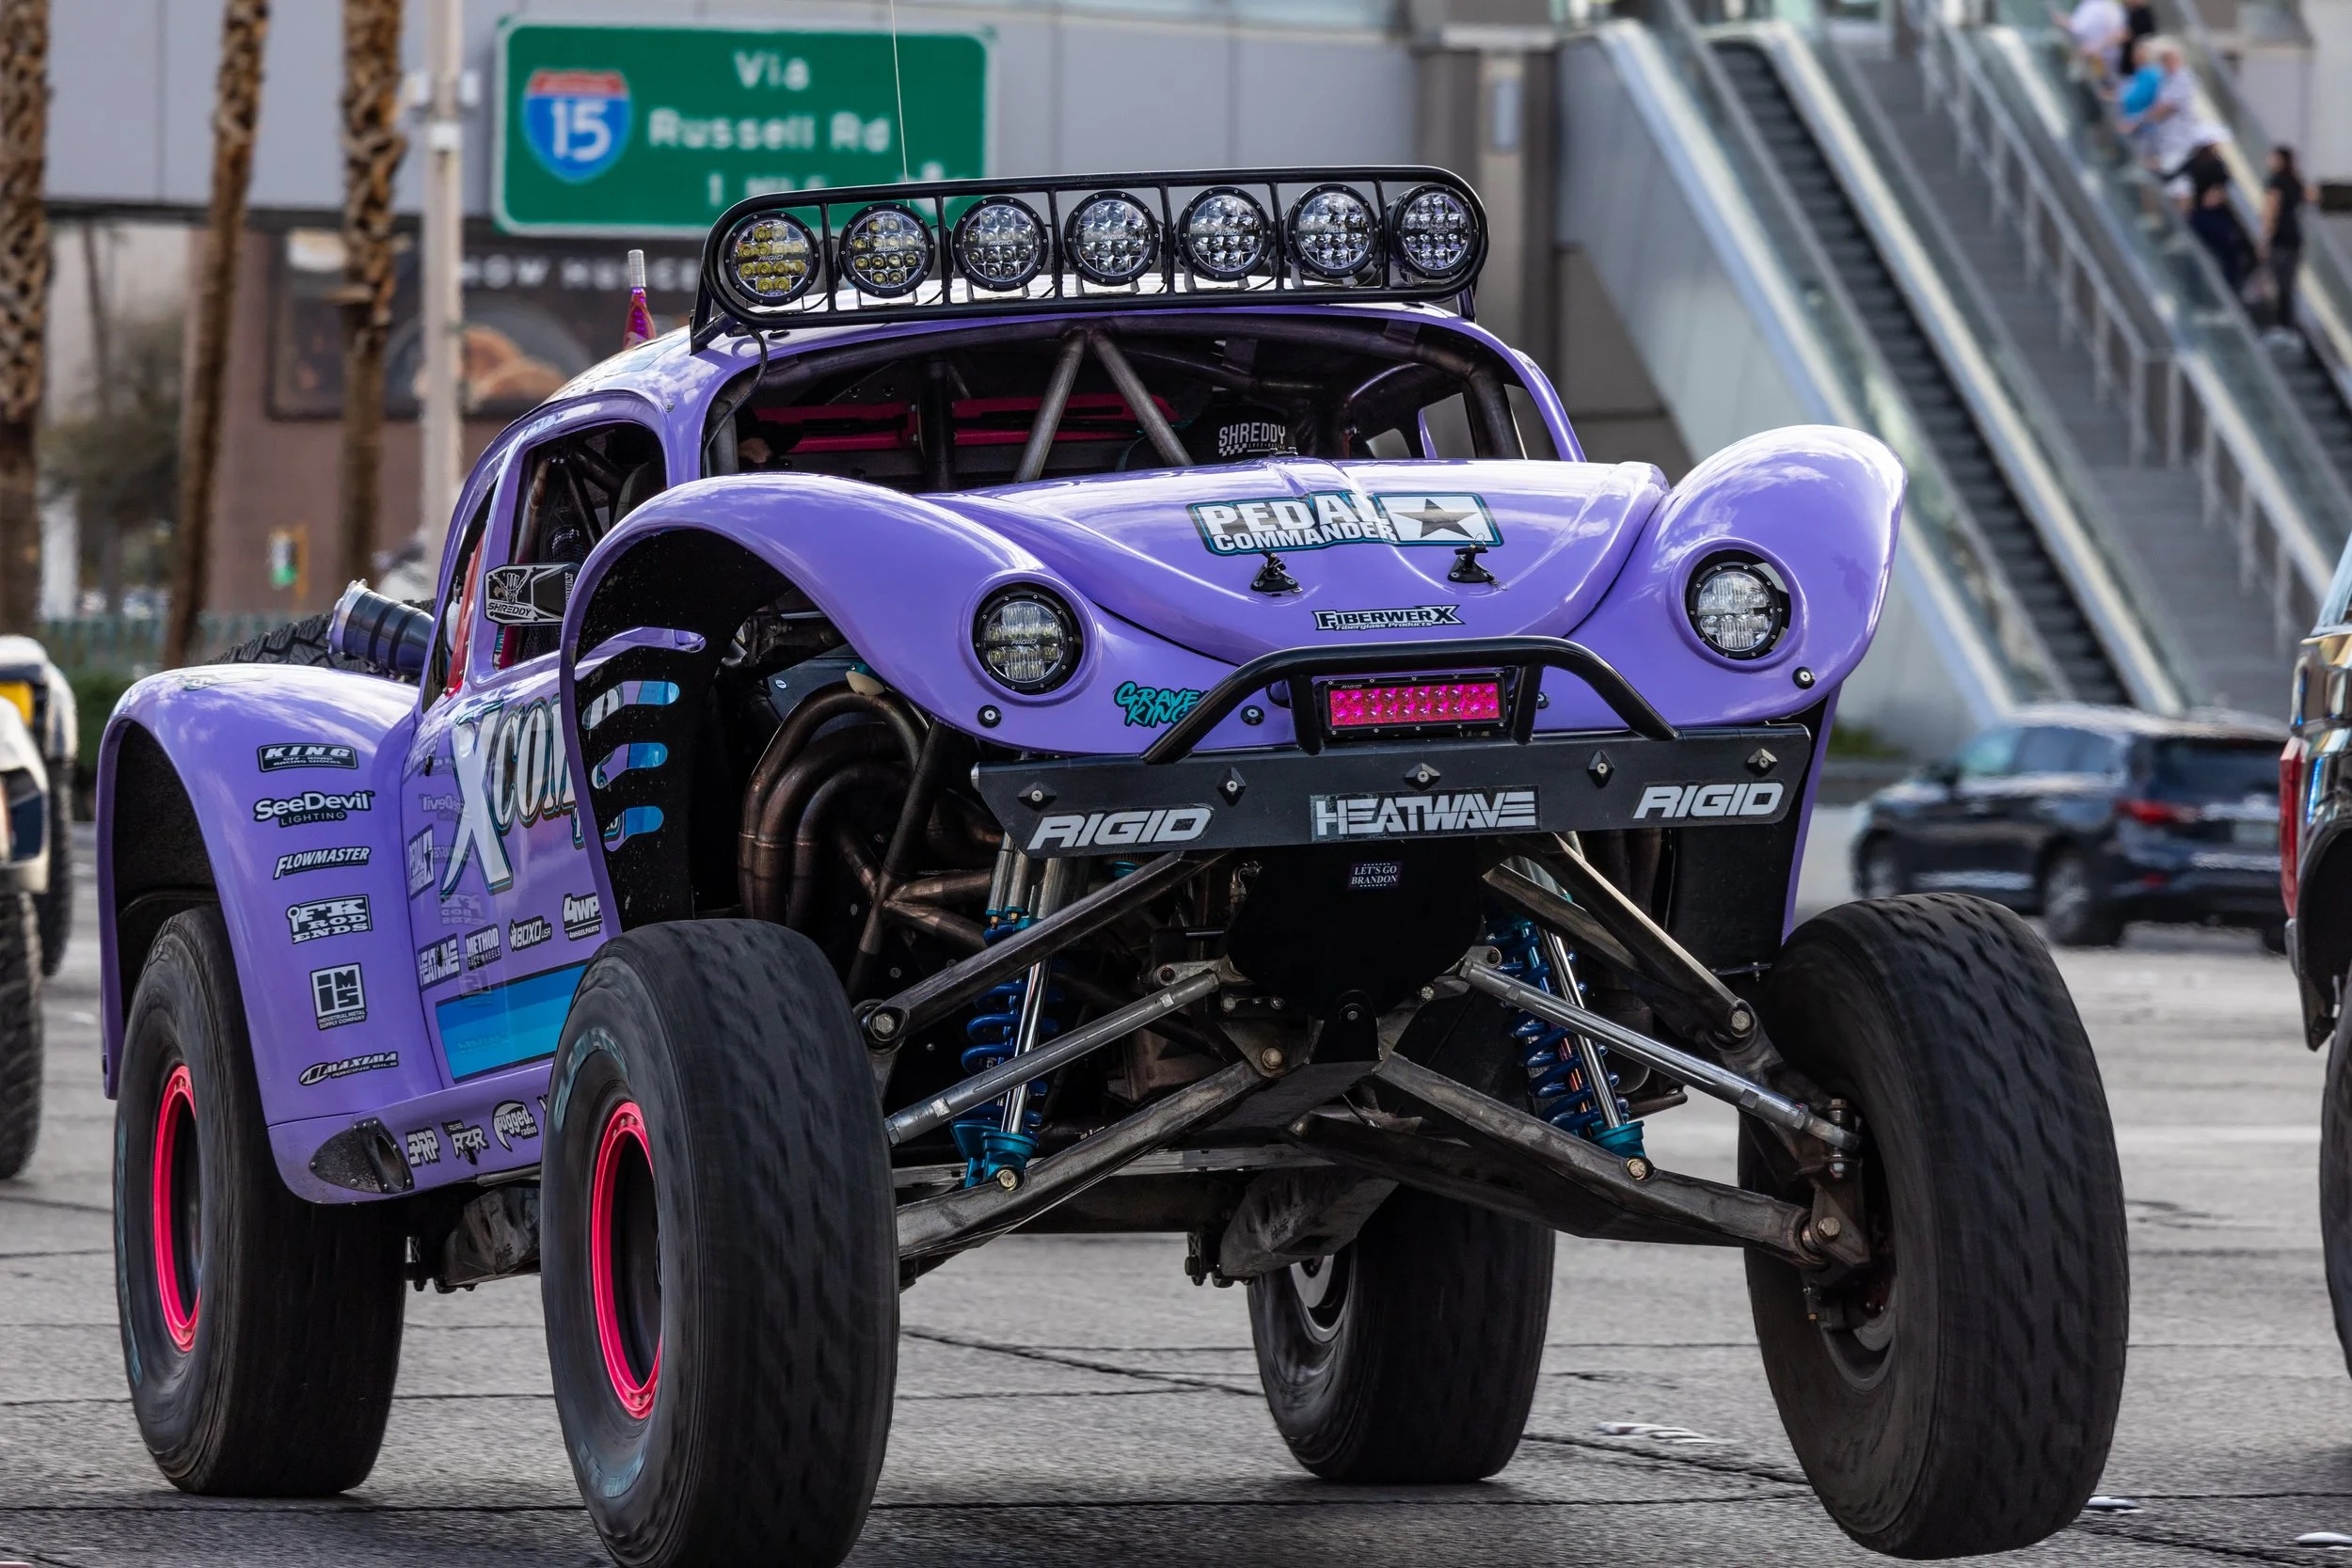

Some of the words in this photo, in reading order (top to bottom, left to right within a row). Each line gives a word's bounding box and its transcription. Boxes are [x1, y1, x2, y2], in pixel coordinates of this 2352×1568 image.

[734, 51, 810, 90] Via
[551, 100, 612, 162] 15
[649, 107, 816, 150] Russell
[830, 111, 891, 152] Rd
[1218, 422, 1285, 447] SHREDDY
[1200, 493, 1390, 534] PEDAL
[1214, 522, 1397, 551] COMMANDER
[487, 602, 532, 616] SHREDDY
[1117, 682, 1200, 710] GRAVE
[264, 746, 351, 759] KING
[255, 792, 369, 819] SeeDevil
[1316, 791, 1536, 835] HEATWAVE
[1632, 783, 1784, 819] RIGID
[281, 812, 345, 826] LIGHTING
[1027, 808, 1211, 849] RIGID
[274, 847, 370, 879] FLOWMASTER
[1355, 866, 1381, 875] LET'S
[1383, 865, 1397, 874] GO
[1351, 875, 1397, 884] BRANDON
[298, 899, 366, 923] FK
[308, 914, 367, 929] ROD
[564, 895, 600, 924] 4WP
[293, 923, 368, 943] ENDS
[466, 927, 500, 957] METHOD
[516, 920, 543, 948] BOXO
[320, 1021, 338, 1029] SUPPLY
[339, 1015, 365, 1024] COMPANY
[331, 1066, 370, 1077] RACING
[451, 1128, 487, 1156] RZR
[520, 1125, 537, 1136] radios
[407, 1130, 439, 1165] PRP
